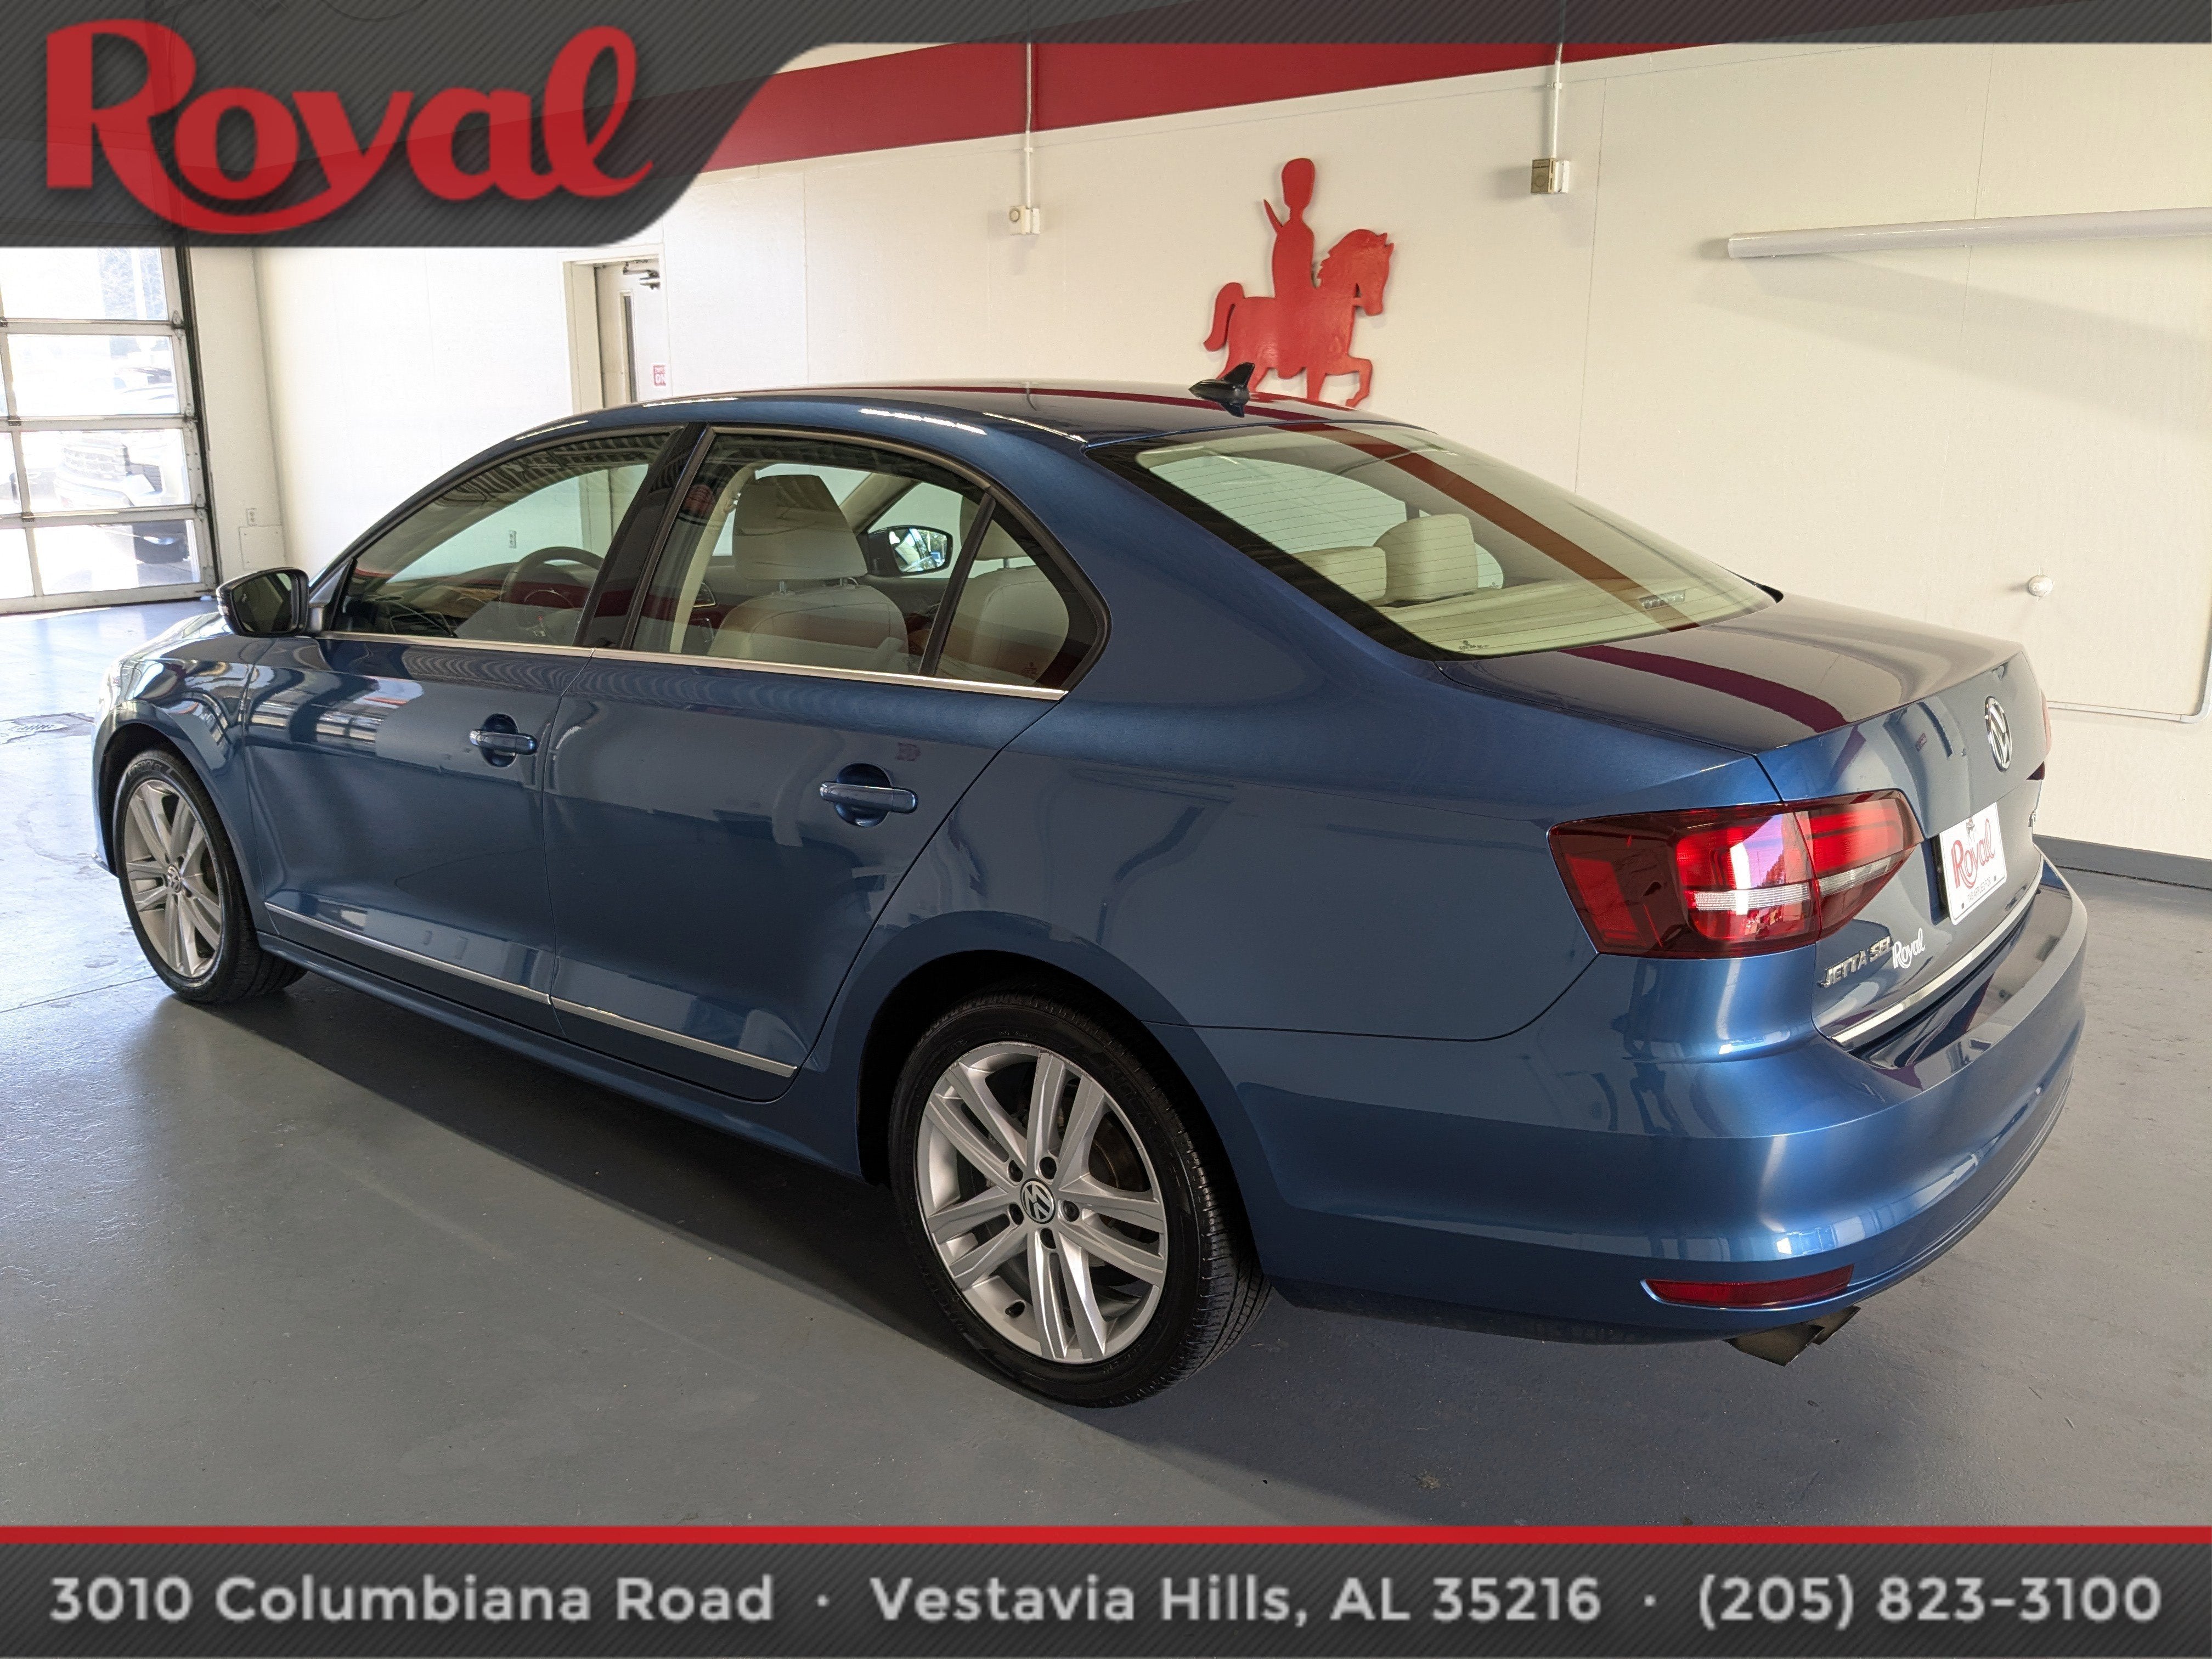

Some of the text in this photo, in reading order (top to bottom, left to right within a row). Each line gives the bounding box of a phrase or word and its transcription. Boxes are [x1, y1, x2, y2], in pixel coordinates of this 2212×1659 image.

[1951, 818, 1995, 889] Royal
[1816, 935, 1893, 988] JETTA SEL
[1893, 928, 1926, 969] Royal
